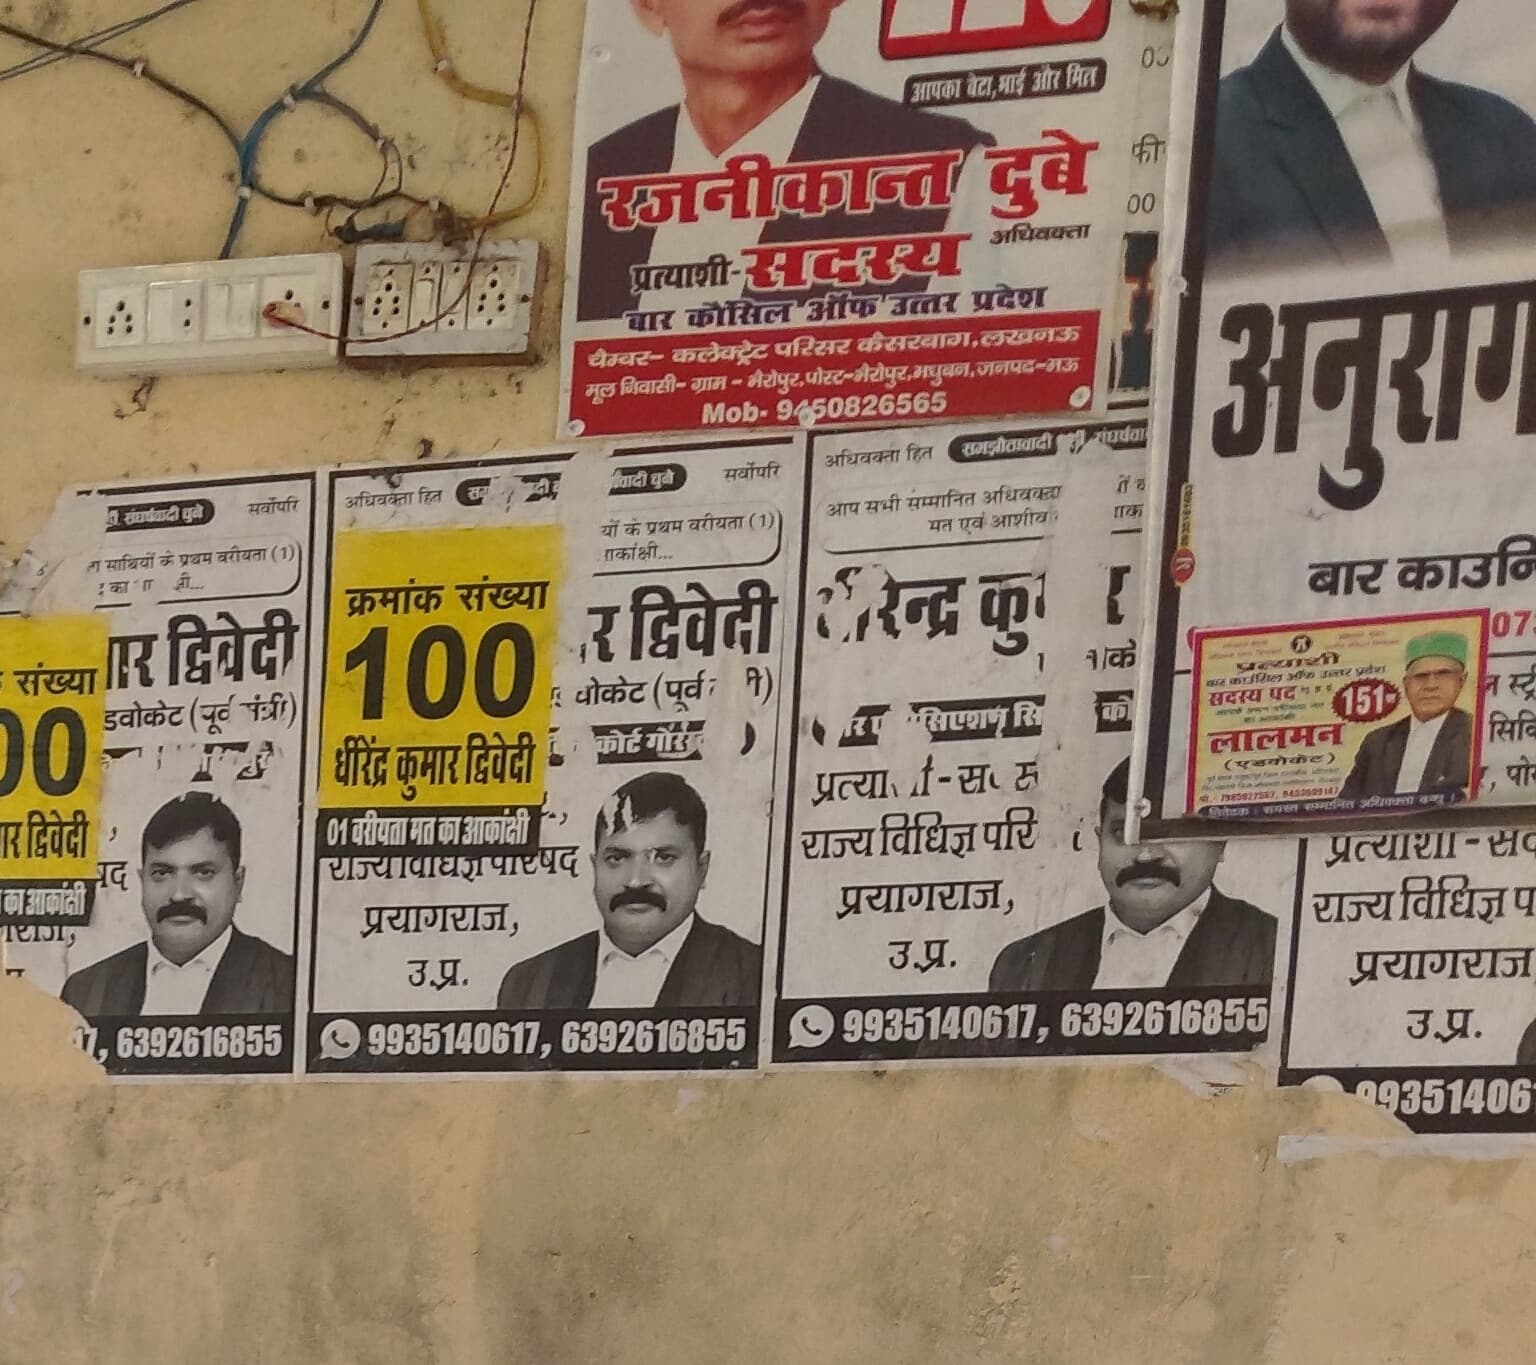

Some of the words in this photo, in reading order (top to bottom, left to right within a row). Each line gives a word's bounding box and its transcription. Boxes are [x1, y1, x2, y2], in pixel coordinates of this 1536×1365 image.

[598, 153, 964, 229] रजनीकान्त
[985, 129, 1099, 219] दुबे
[990, 224, 1091, 245] अधिवक्ता
[741, 233, 972, 289] सदस्य
[888, 292, 960, 316] उत्तर
[972, 283, 1048, 312] प्रदेश
[825, 447, 901, 468] अधिवक्ता
[905, 444, 934, 465] हित
[345, 490, 414, 509] अधिवक्ता
[418, 486, 443, 506] हित
[826, 502, 860, 518] आप
[866, 494, 899, 515] सभी
[645, 517, 683, 537] प्रथम
[688, 512, 744, 533] वरीयता
[179, 552, 213, 571] प्रथम
[218, 546, 268, 565] वरीयता
[346, 577, 445, 617] क्रमांक
[455, 575, 550, 612] संख्या
[1308, 558, 1386, 597] बार
[630, 578, 779, 660] द्विवेदी
[168, 608, 300, 689] द्विवेदी
[13, 662, 98, 698] संख्या
[345, 621, 535, 721] 100
[104, 700, 184, 732] डवोकेट
[1343, 684, 1384, 715] 151
[1207, 723, 1346, 754] लालमन
[396, 744, 461, 801] कुमार
[464, 732, 536, 787] द्विवेदी
[27, 809, 90, 861] द्विवेदी
[800, 829, 873, 860] राज्य
[879, 812, 974, 860] विधिज्ञ
[836, 879, 1015, 919] प्रयागराज,
[1313, 891, 1396, 923] राज्य
[1399, 874, 1506, 925] विधिज्ञ
[360, 903, 520, 938] प्रयागराज,
[1060, 997, 1269, 1037] 6392616855
[116, 1024, 283, 1059] 6392616855
[561, 1018, 747, 1055] 6392616855
